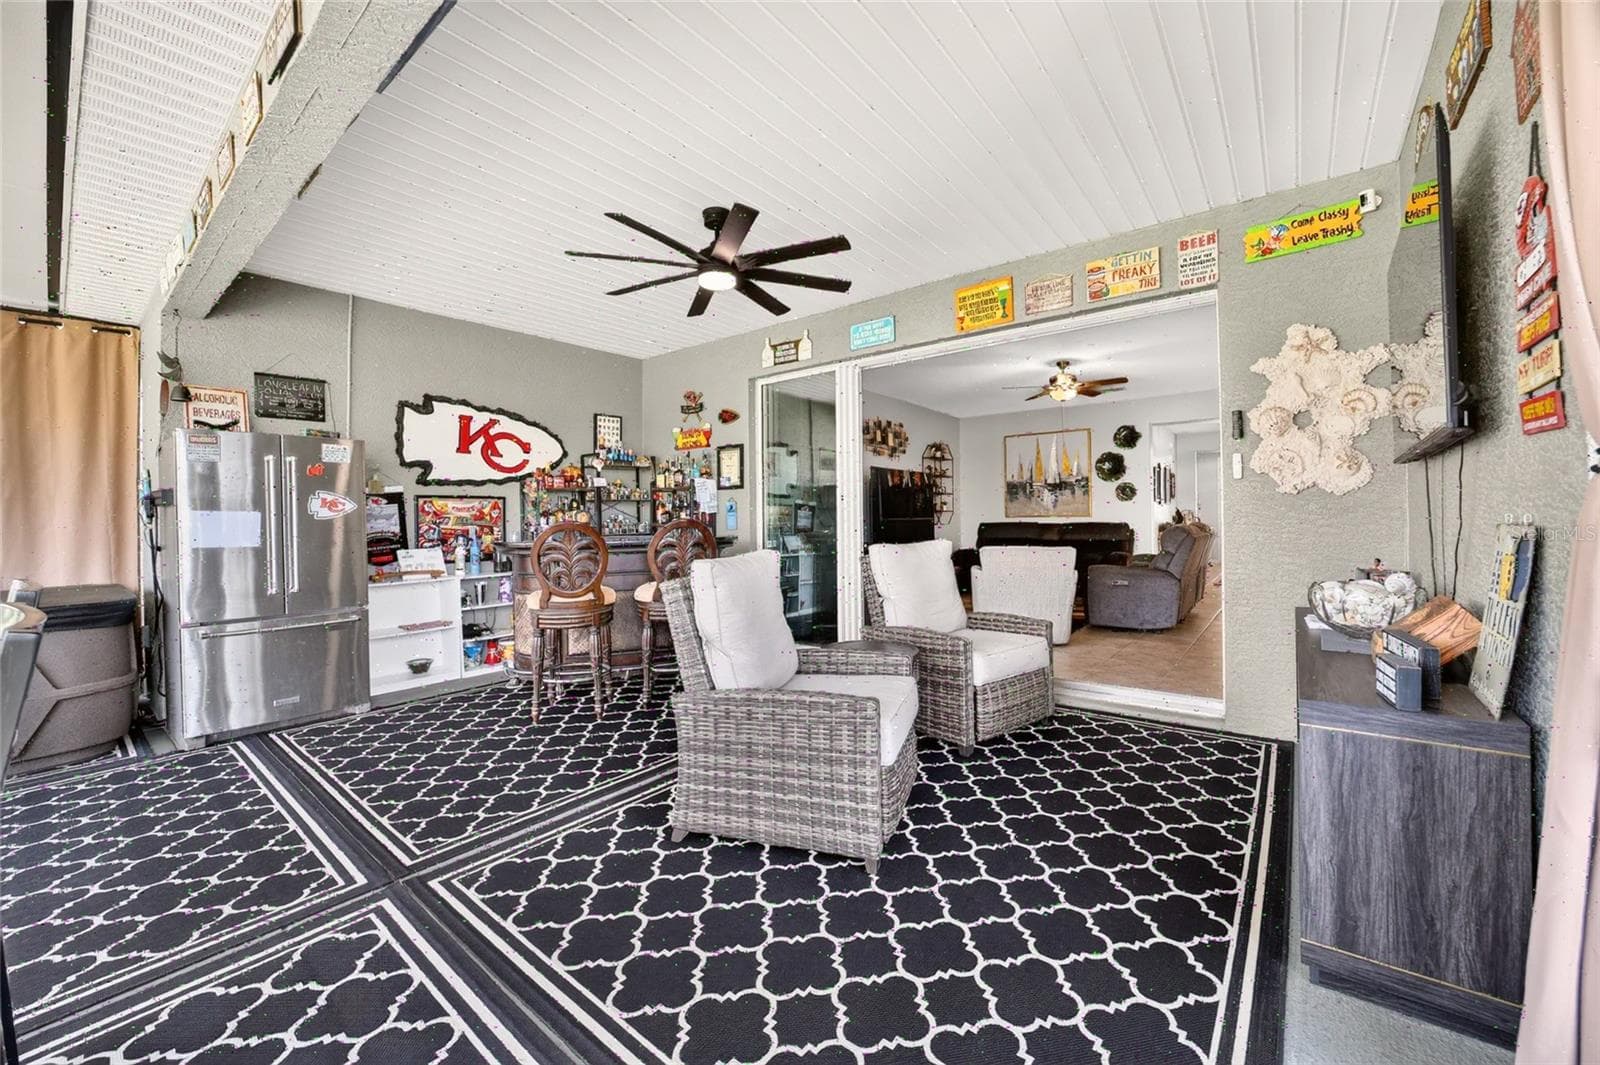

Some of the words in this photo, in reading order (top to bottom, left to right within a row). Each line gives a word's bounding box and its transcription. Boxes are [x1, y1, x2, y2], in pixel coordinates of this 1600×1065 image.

[1290, 216, 1315, 229] Come
[1318, 207, 1349, 222] Classy
[1179, 232, 1216, 252] BEER
[1291, 231, 1319, 246] Leave
[1319, 222, 1354, 238] Trashy
[192, 393, 239, 406] ALCOHOLIC
[193, 407, 242, 420] BEVERAGES
[456, 414, 531, 474] KC
[320, 497, 346, 513] KC
